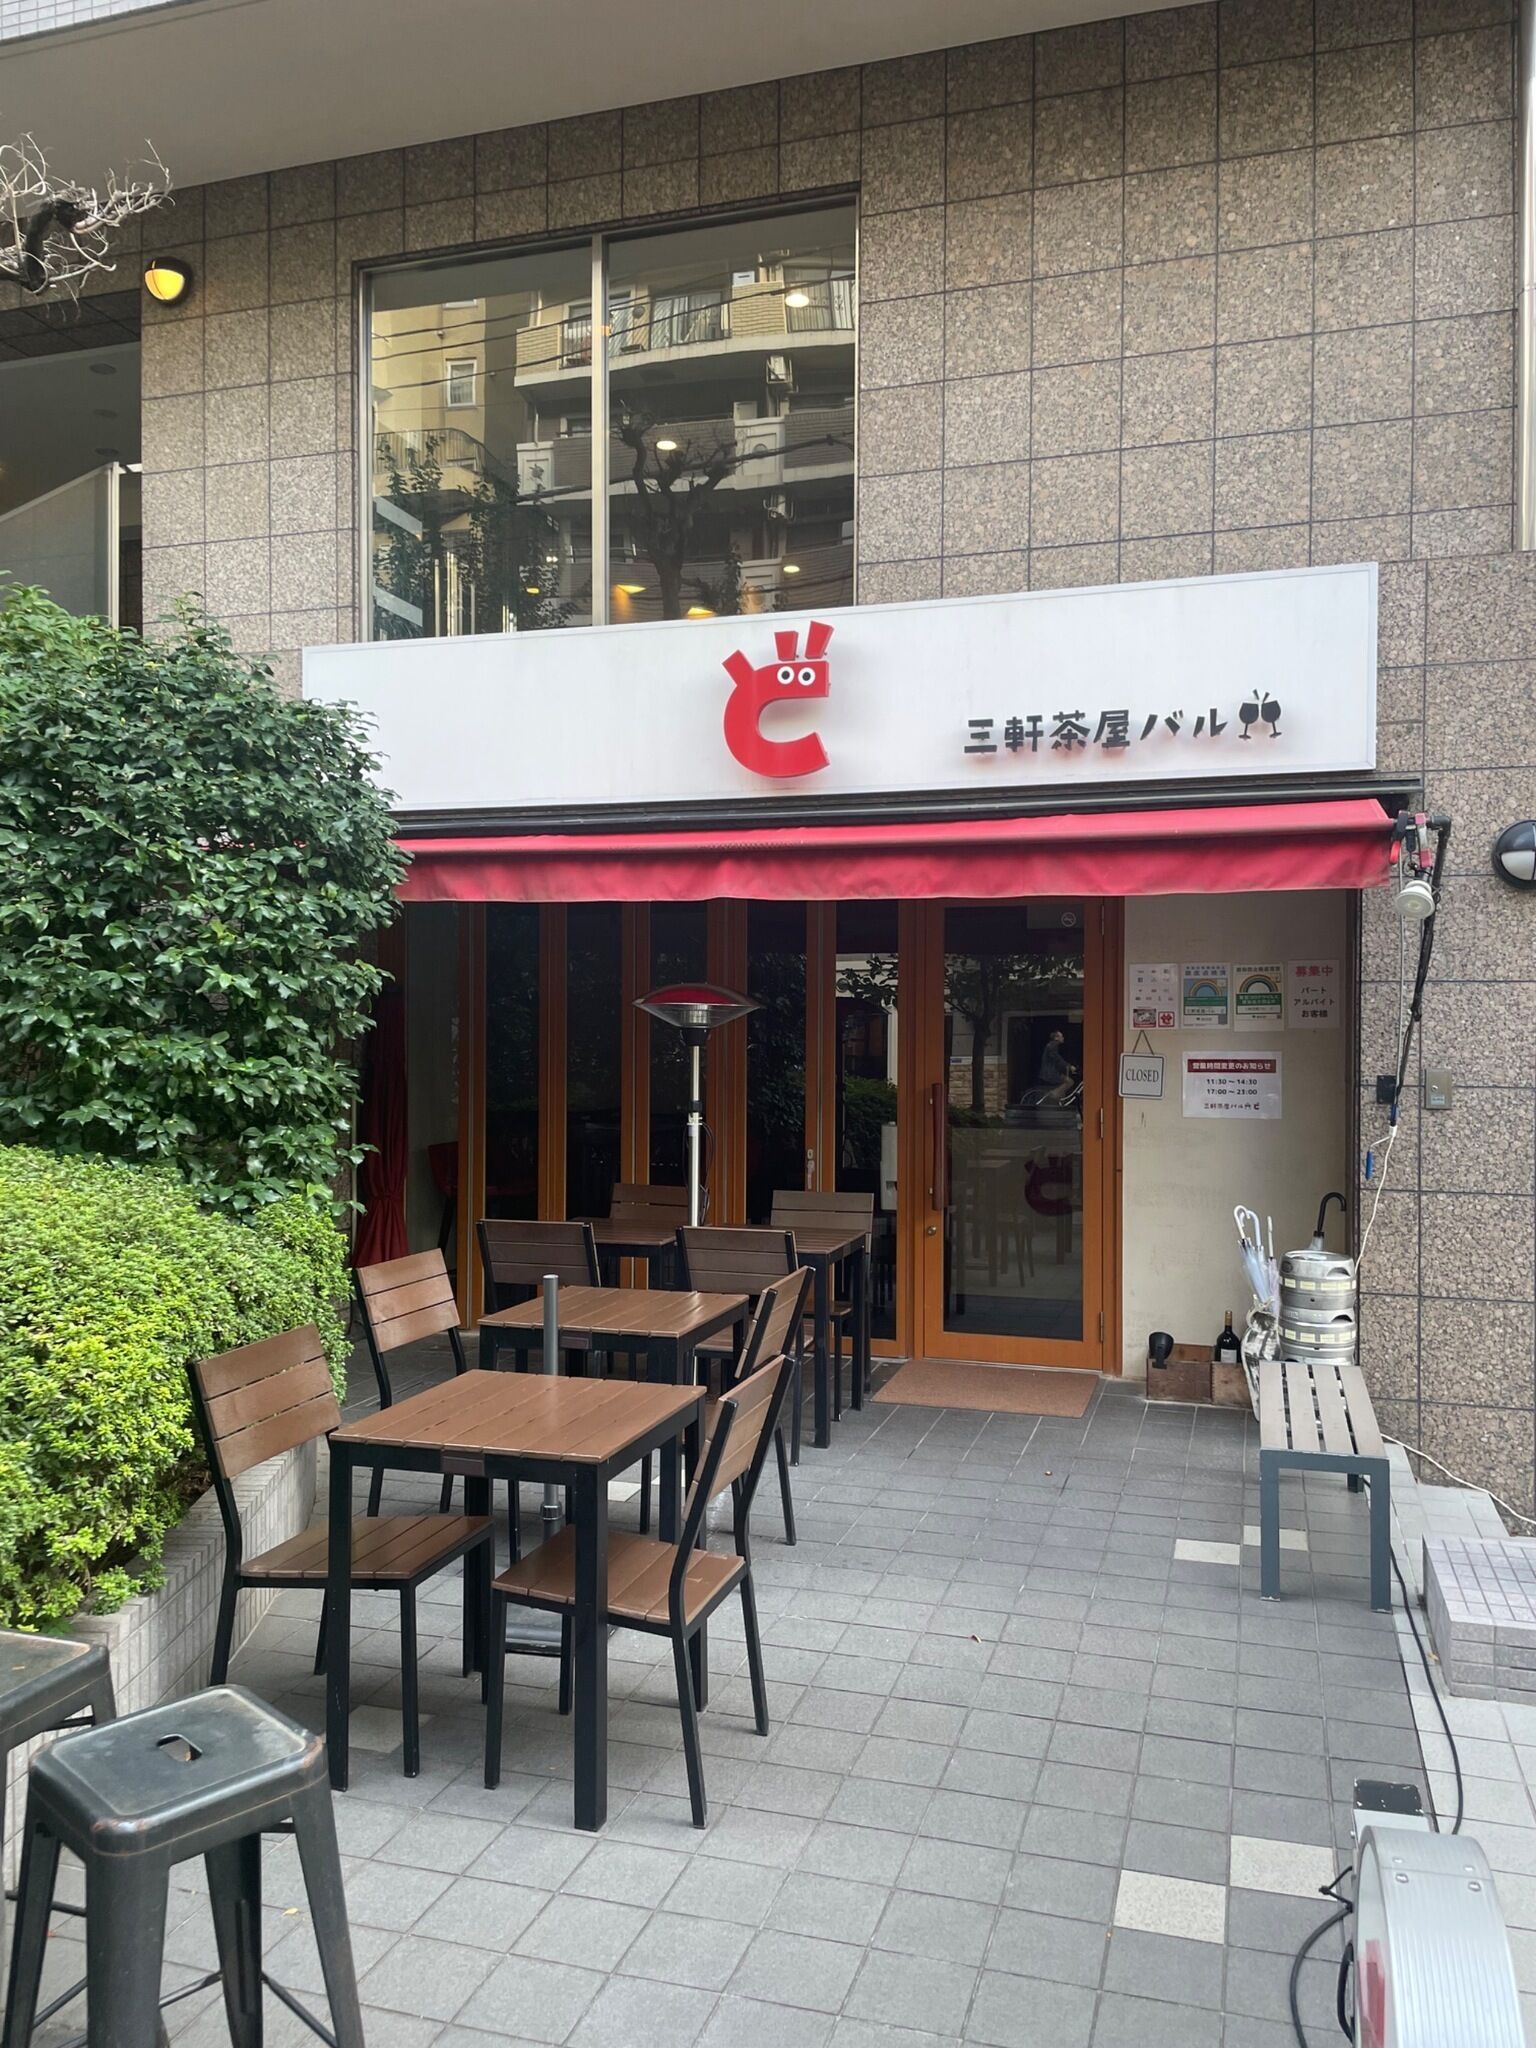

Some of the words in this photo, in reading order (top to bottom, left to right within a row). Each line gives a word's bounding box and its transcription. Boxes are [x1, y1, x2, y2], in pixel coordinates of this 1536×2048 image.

[964, 708, 1228, 753] 三軒茶屋バル
[1293, 998, 1335, 1006] アルバイト
[1125, 1068, 1159, 1083] CLOSED
